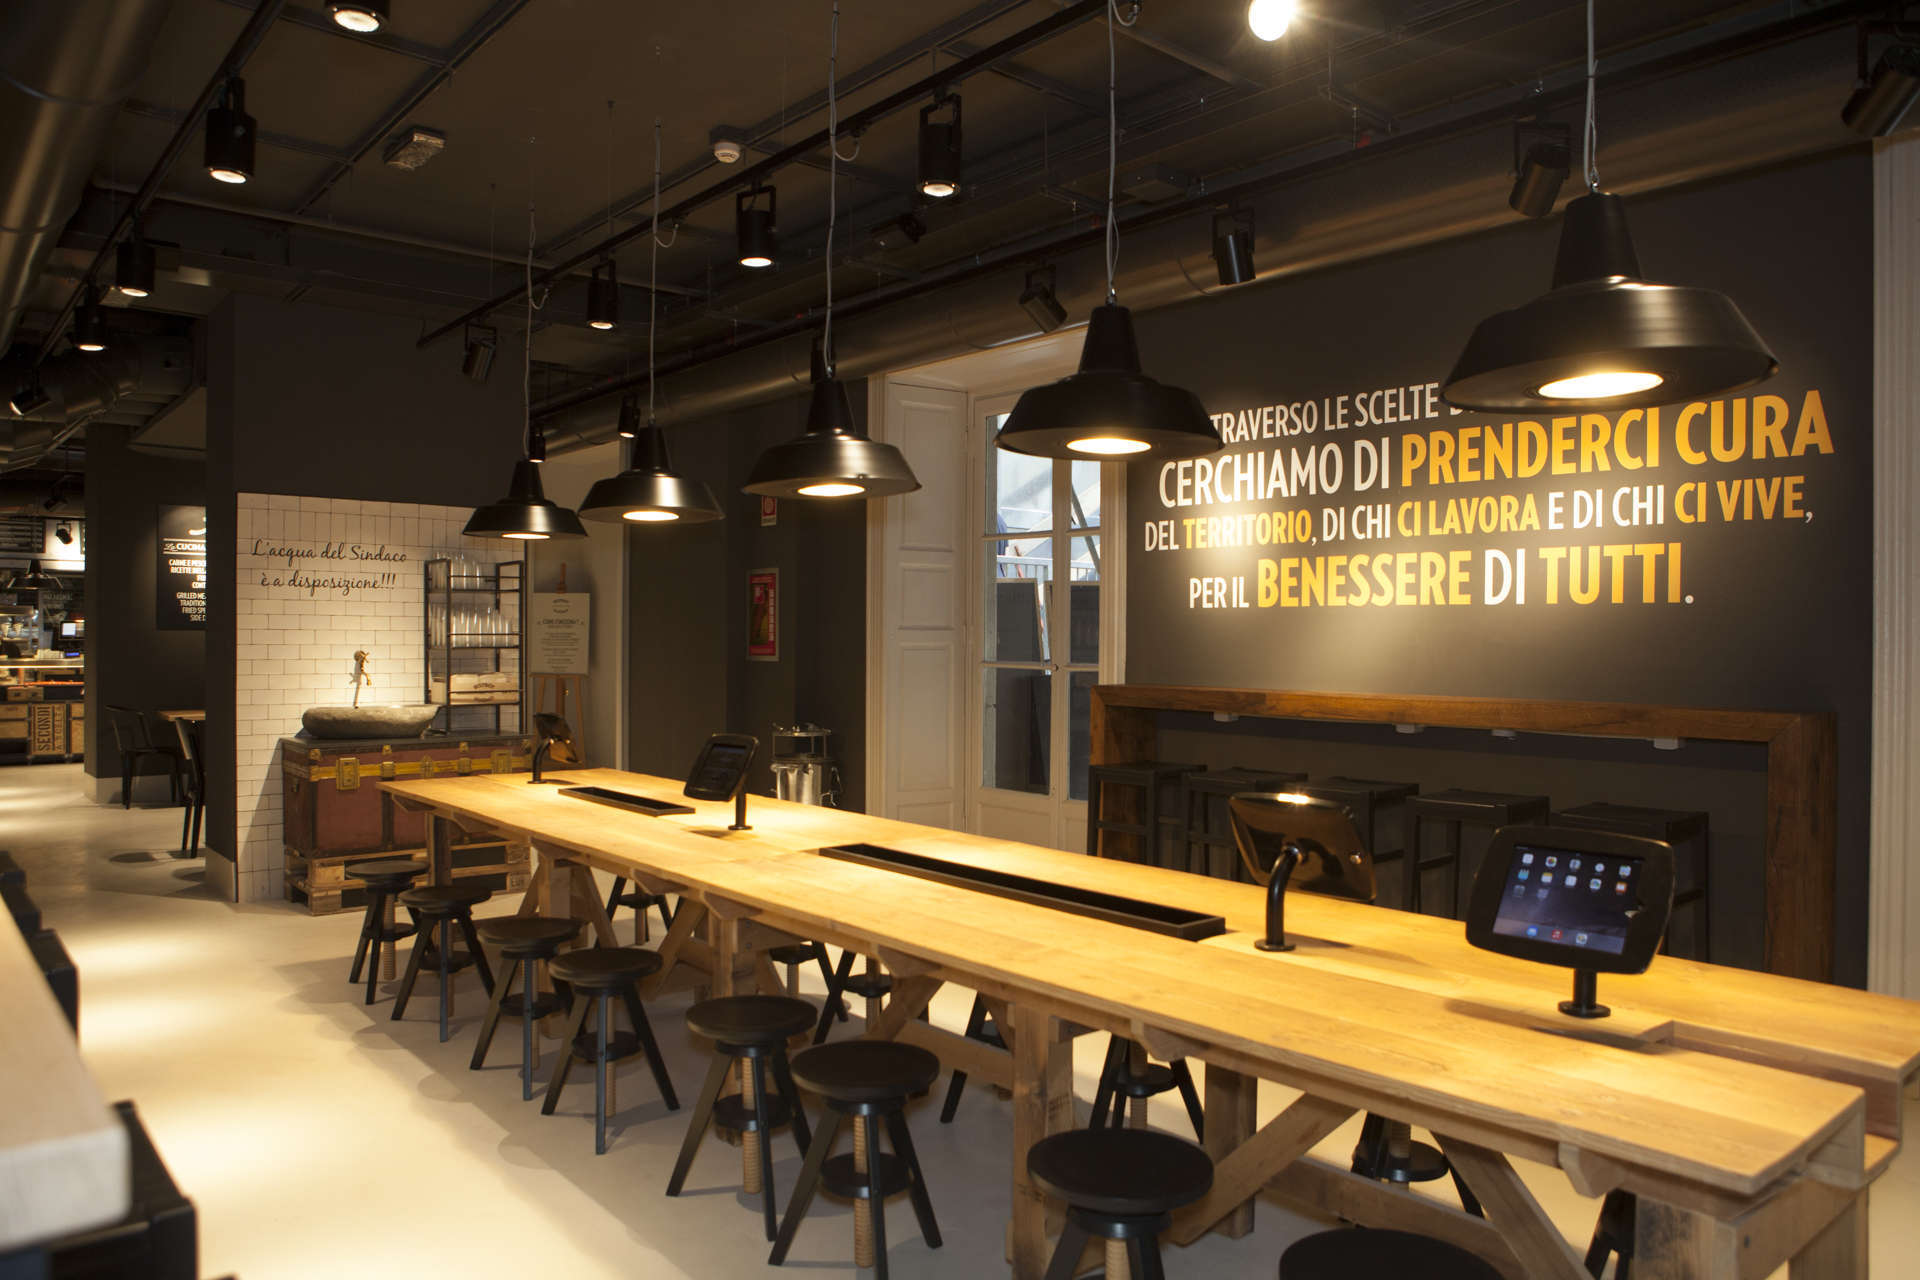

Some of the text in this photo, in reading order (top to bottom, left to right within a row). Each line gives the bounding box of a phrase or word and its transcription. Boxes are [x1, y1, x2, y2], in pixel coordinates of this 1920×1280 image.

[1324, 395, 1349, 431] LE
[1354, 382, 1440, 427] SCELTE
[1159, 389, 1835, 509] CERCHIAMO DI PRENDERCI CURA
[1145, 475, 1814, 551] DEL TERRITORIO, DI CHI CI LAVORA E DI CHI CI VIVE,
[251, 538, 409, 568] L'acqua del Sindaco
[1189, 542, 1695, 609] PER IL BENESSERE DI TUTTI.
[260, 570, 397, 598] è a disposizione!!!
[37, 705, 51, 752] SECONDI
